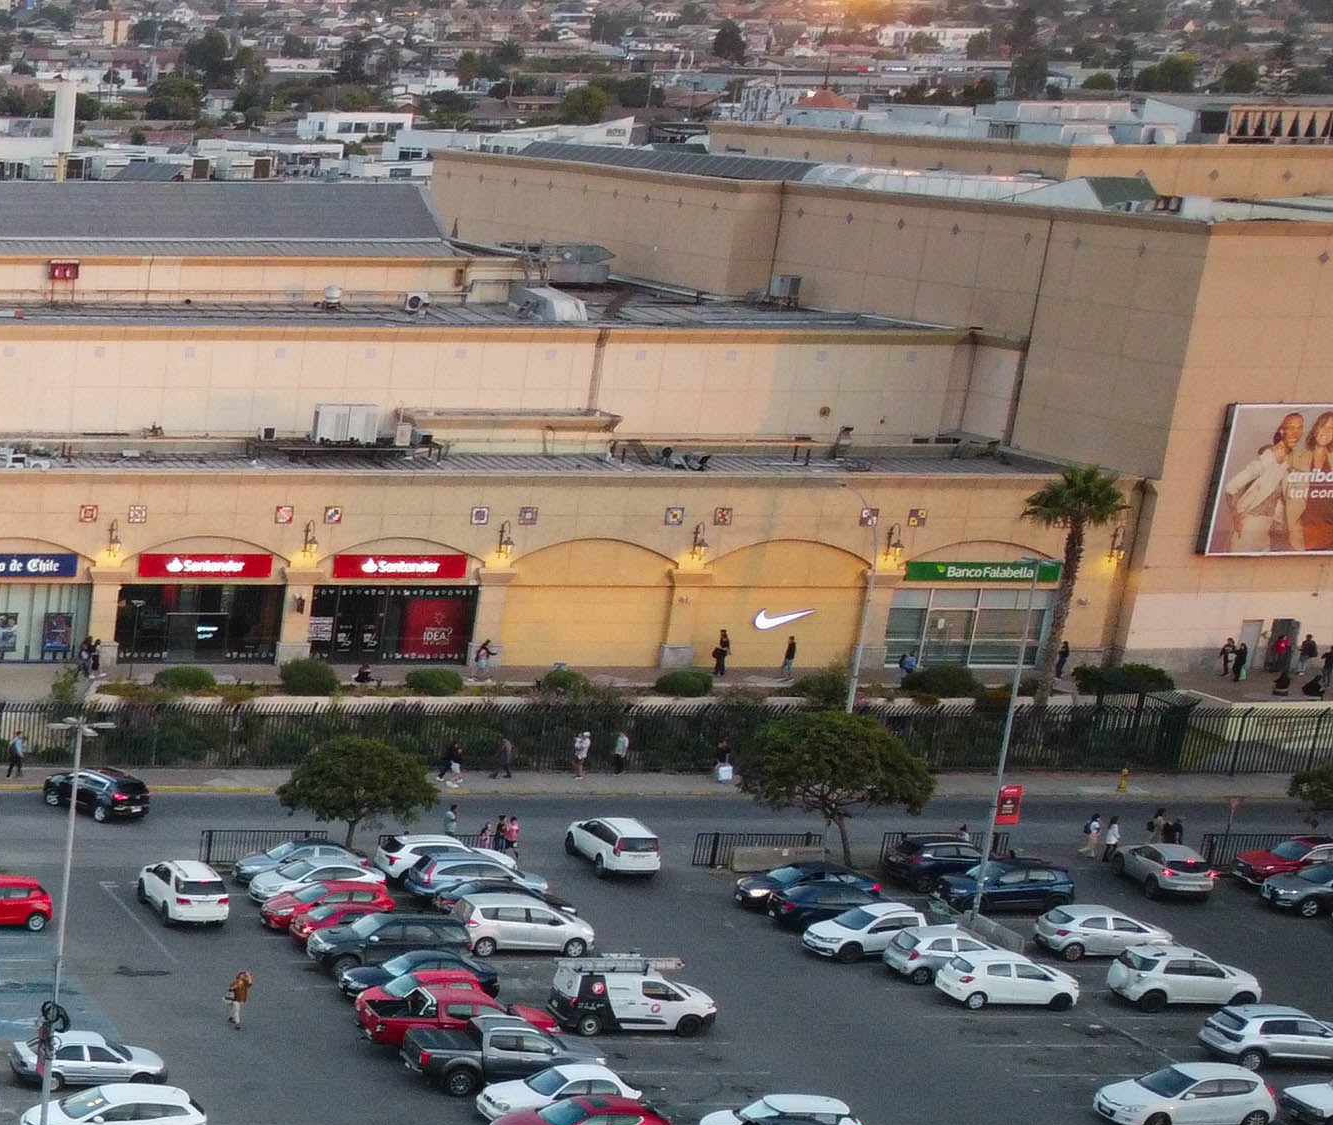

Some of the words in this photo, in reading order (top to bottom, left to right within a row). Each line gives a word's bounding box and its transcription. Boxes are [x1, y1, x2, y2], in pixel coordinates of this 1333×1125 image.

[9, 559, 23, 572] de
[27, 558, 60, 573] Chile
[183, 558, 245, 572] Santander
[378, 559, 441, 573] Santander
